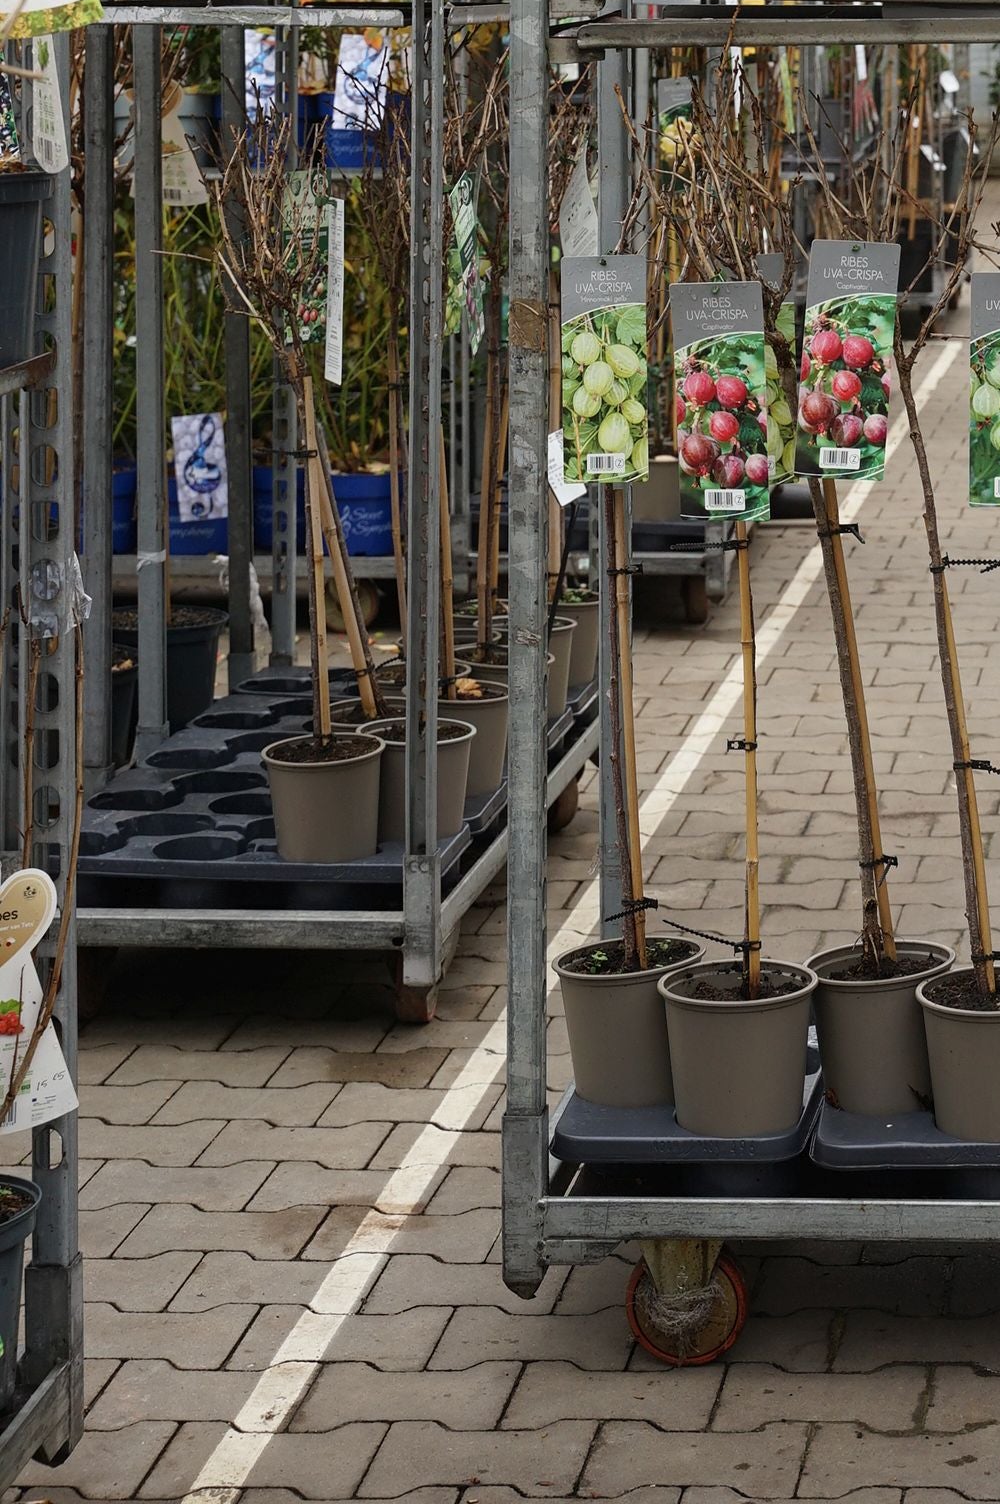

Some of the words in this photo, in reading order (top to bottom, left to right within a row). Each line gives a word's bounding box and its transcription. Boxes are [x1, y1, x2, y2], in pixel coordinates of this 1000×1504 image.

[840, 255, 869, 268] RIBES
[590, 270, 617, 281] RIBES
[823, 268, 884, 281] UVA-CRISPA
[575, 281, 633, 294] UVA-CRISPA
[702, 297, 731, 308] RIBES
[686, 309, 749, 321] UVA-CRISPA
[0, 910, 19, 921] es
